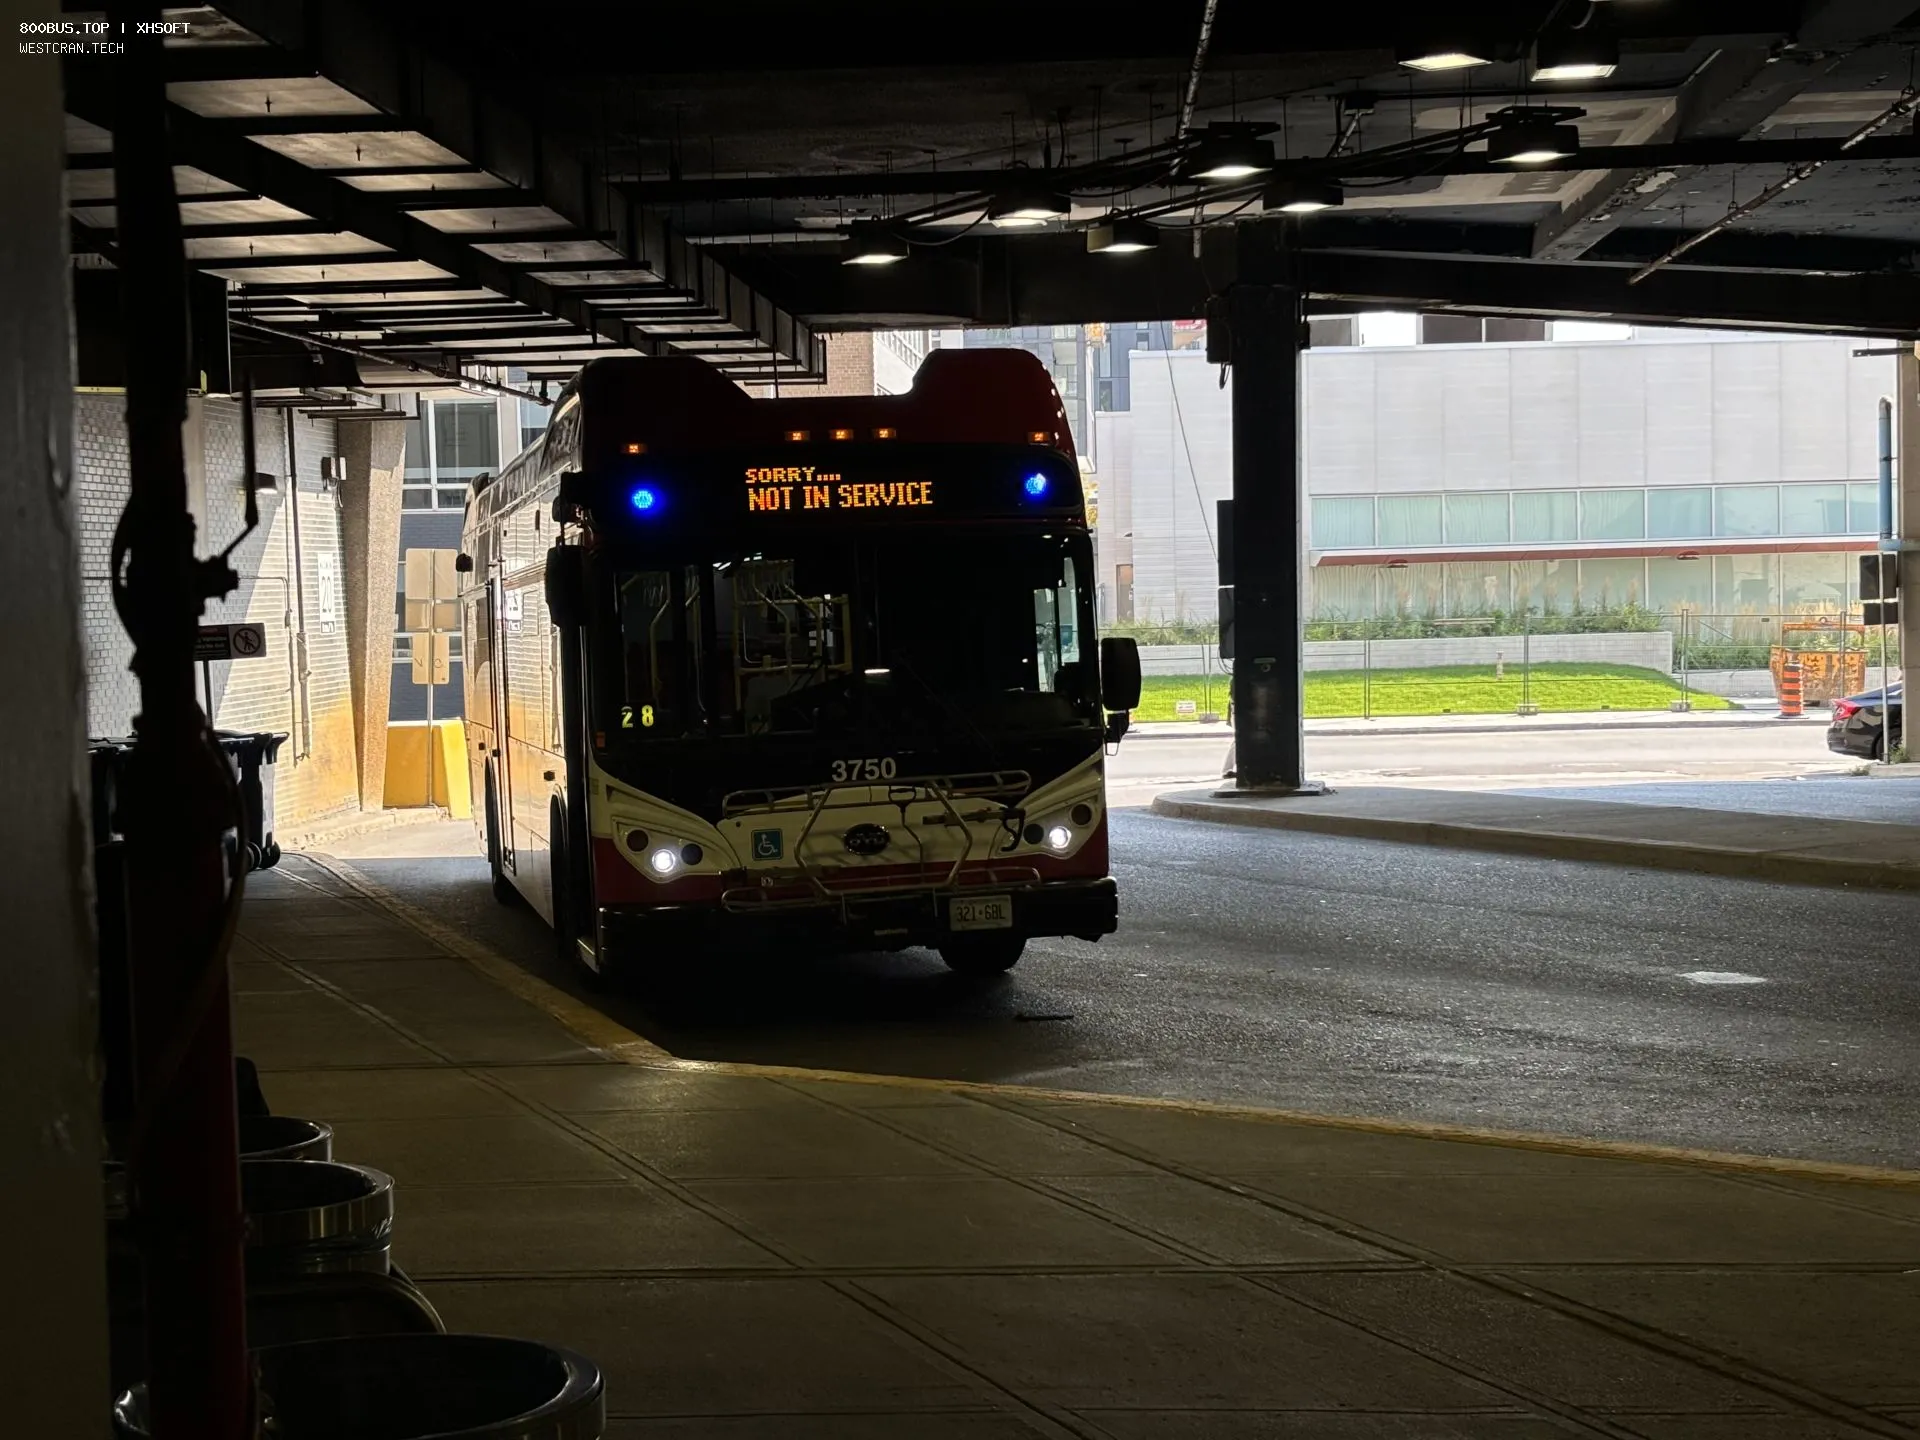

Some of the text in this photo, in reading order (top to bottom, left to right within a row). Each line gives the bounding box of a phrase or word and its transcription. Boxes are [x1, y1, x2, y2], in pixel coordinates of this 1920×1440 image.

[745, 466, 841, 484] SORRY....
[748, 481, 933, 511] NOT IN SERVICE
[831, 756, 897, 783] 3750
